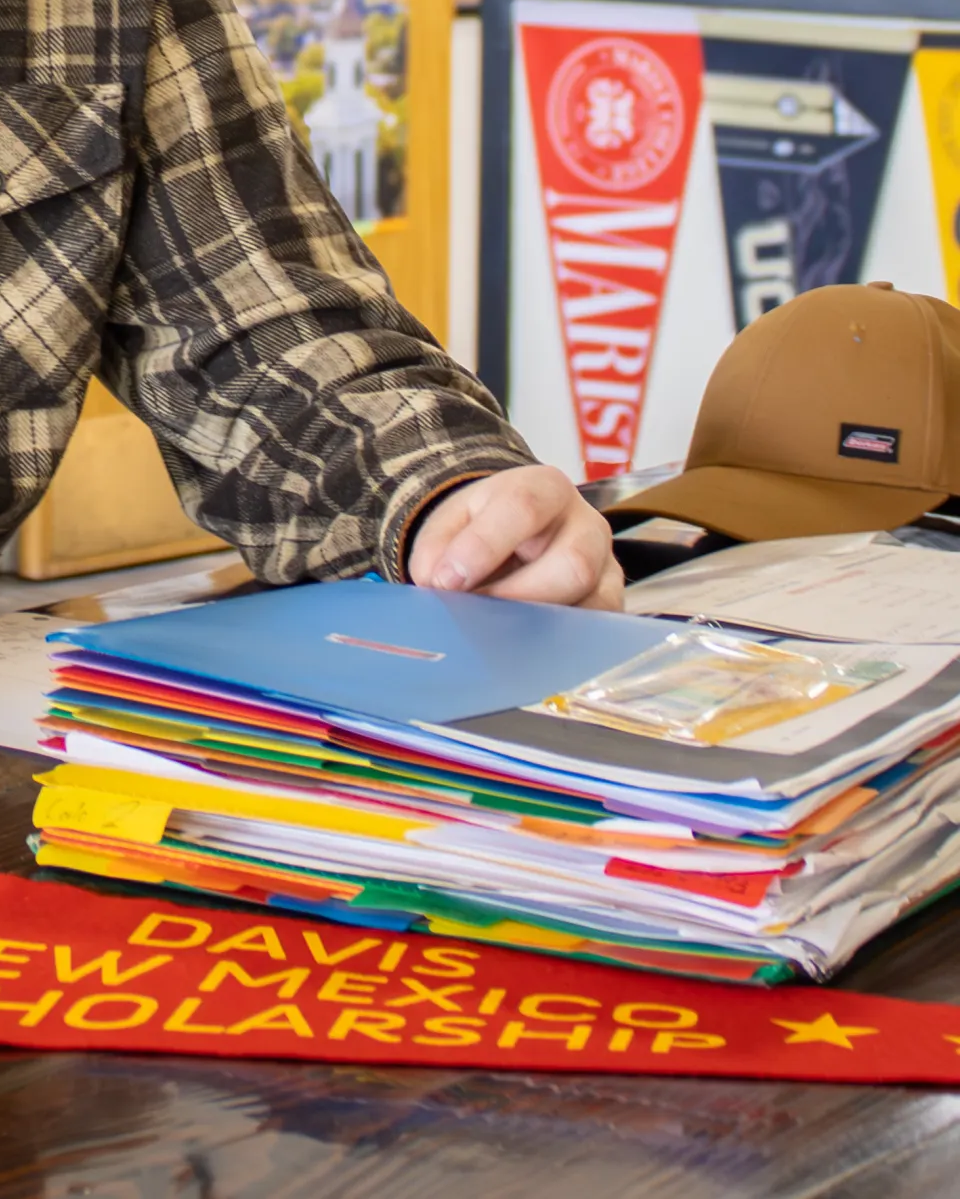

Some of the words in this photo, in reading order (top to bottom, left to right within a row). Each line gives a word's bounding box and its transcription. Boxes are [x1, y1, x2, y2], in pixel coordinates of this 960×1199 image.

[544, 188, 680, 475] MARIST
[128, 912, 482, 978] DAVIS
[199, 960, 698, 1029] MEXICO
